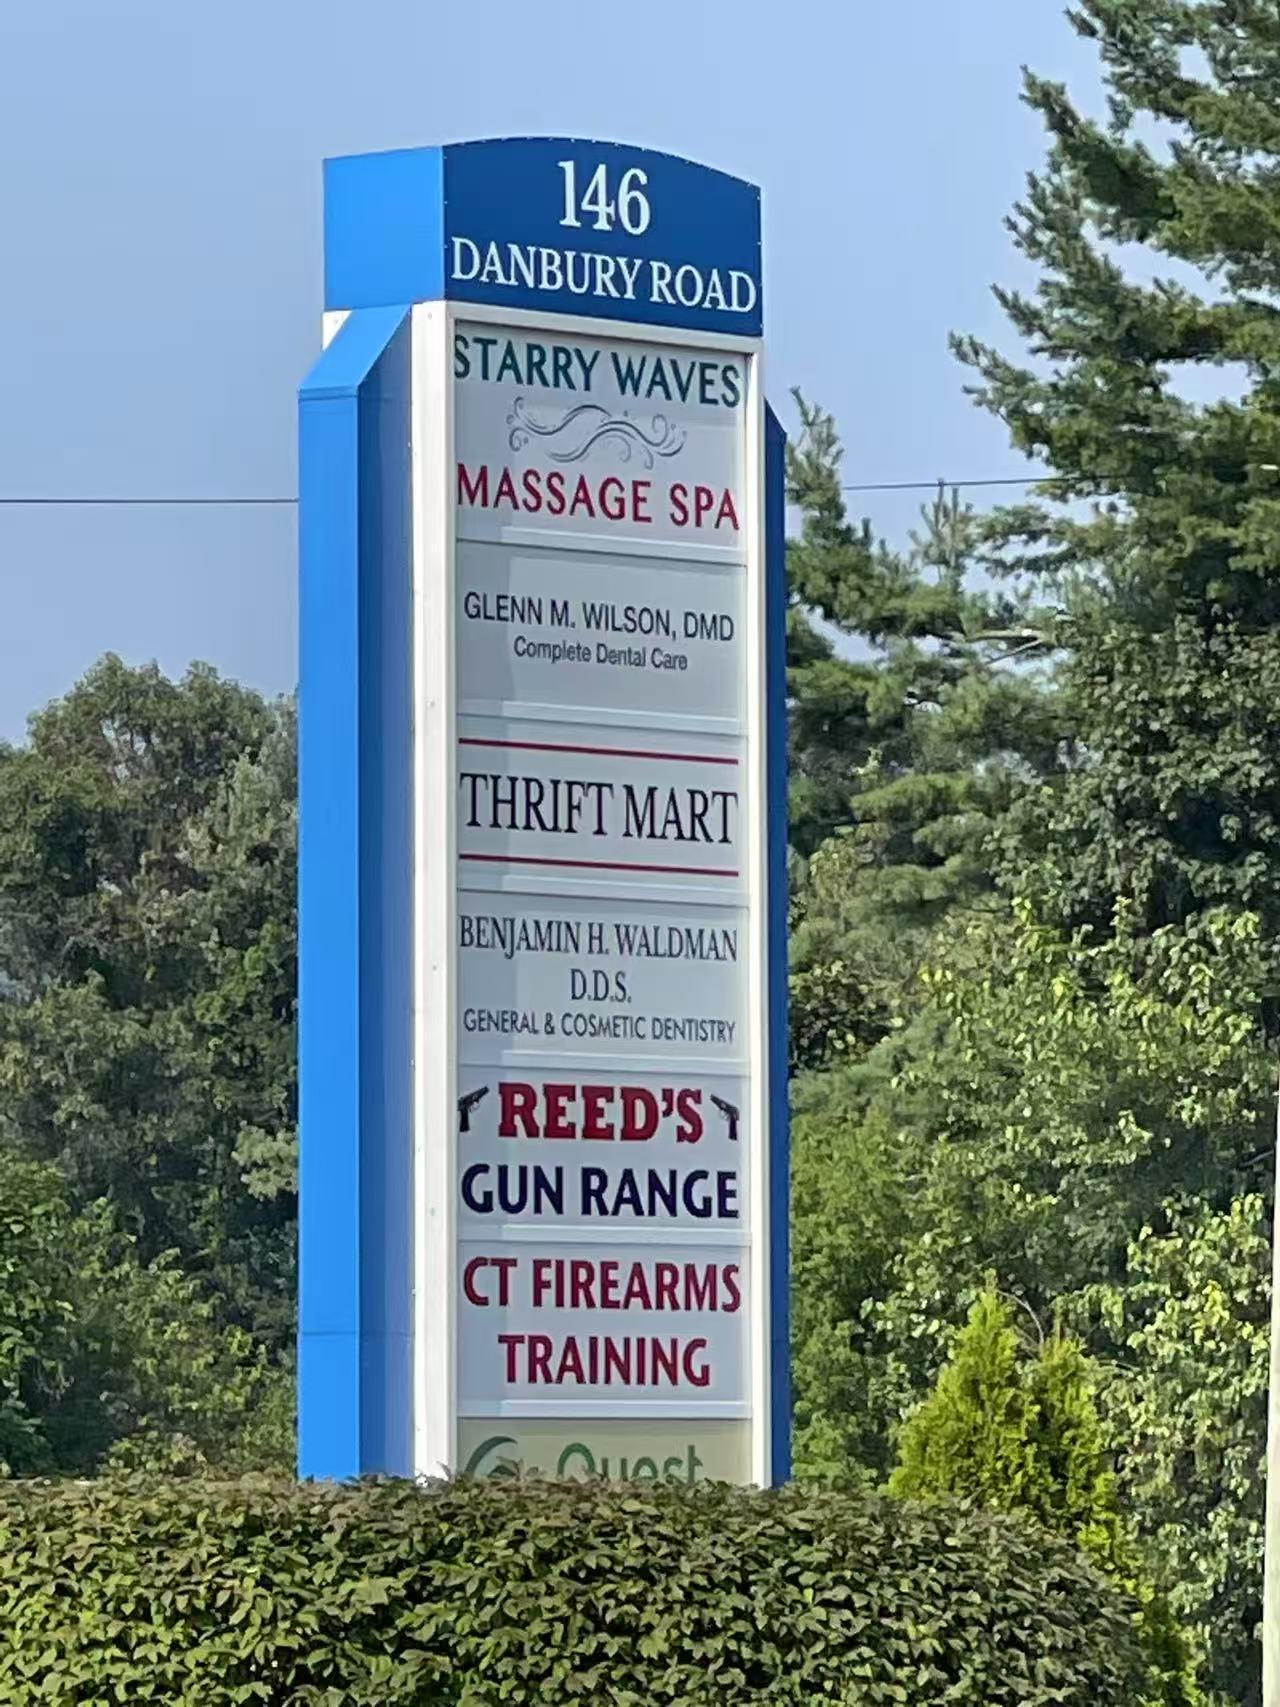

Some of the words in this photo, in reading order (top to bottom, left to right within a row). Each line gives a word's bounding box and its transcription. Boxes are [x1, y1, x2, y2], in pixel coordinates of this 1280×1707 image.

[557, 160, 651, 235] 146
[451, 237, 642, 300] DANBURY
[649, 261, 757, 313] ROAD
[454, 334, 600, 392] STARRY
[611, 352, 741, 408] WAVES
[457, 463, 652, 523] MASSAGE
[669, 483, 740, 530] SPA
[464, 591, 542, 625] GLENN
[551, 600, 576, 629] M.
[582, 602, 677, 641] WILSON,
[684, 612, 734, 641] DMD
[514, 635, 591, 664] Complete
[596, 643, 646, 667] Dental
[651, 648, 688, 671] Care
[459, 772, 614, 836] THRIFT
[622, 784, 739, 844] MART
[459, 915, 581, 959] BENJAMIN
[588, 922, 609, 955] H.
[614, 923, 738, 962] WALDMAN
[570, 968, 632, 1003] D.D.S.
[463, 1008, 539, 1035] GENERAL
[544, 1012, 555, 1035] &
[561, 1013, 646, 1040] COSMETIC
[652, 1017, 735, 1043] DENTISTRY
[497, 1082, 703, 1144] REED'S
[462, 1163, 564, 1215] GUN
[581, 1167, 739, 1218] RANGE
[463, 1256, 518, 1306] CT
[532, 1259, 741, 1313] FIREARMS
[498, 1334, 711, 1387] TRAINING
